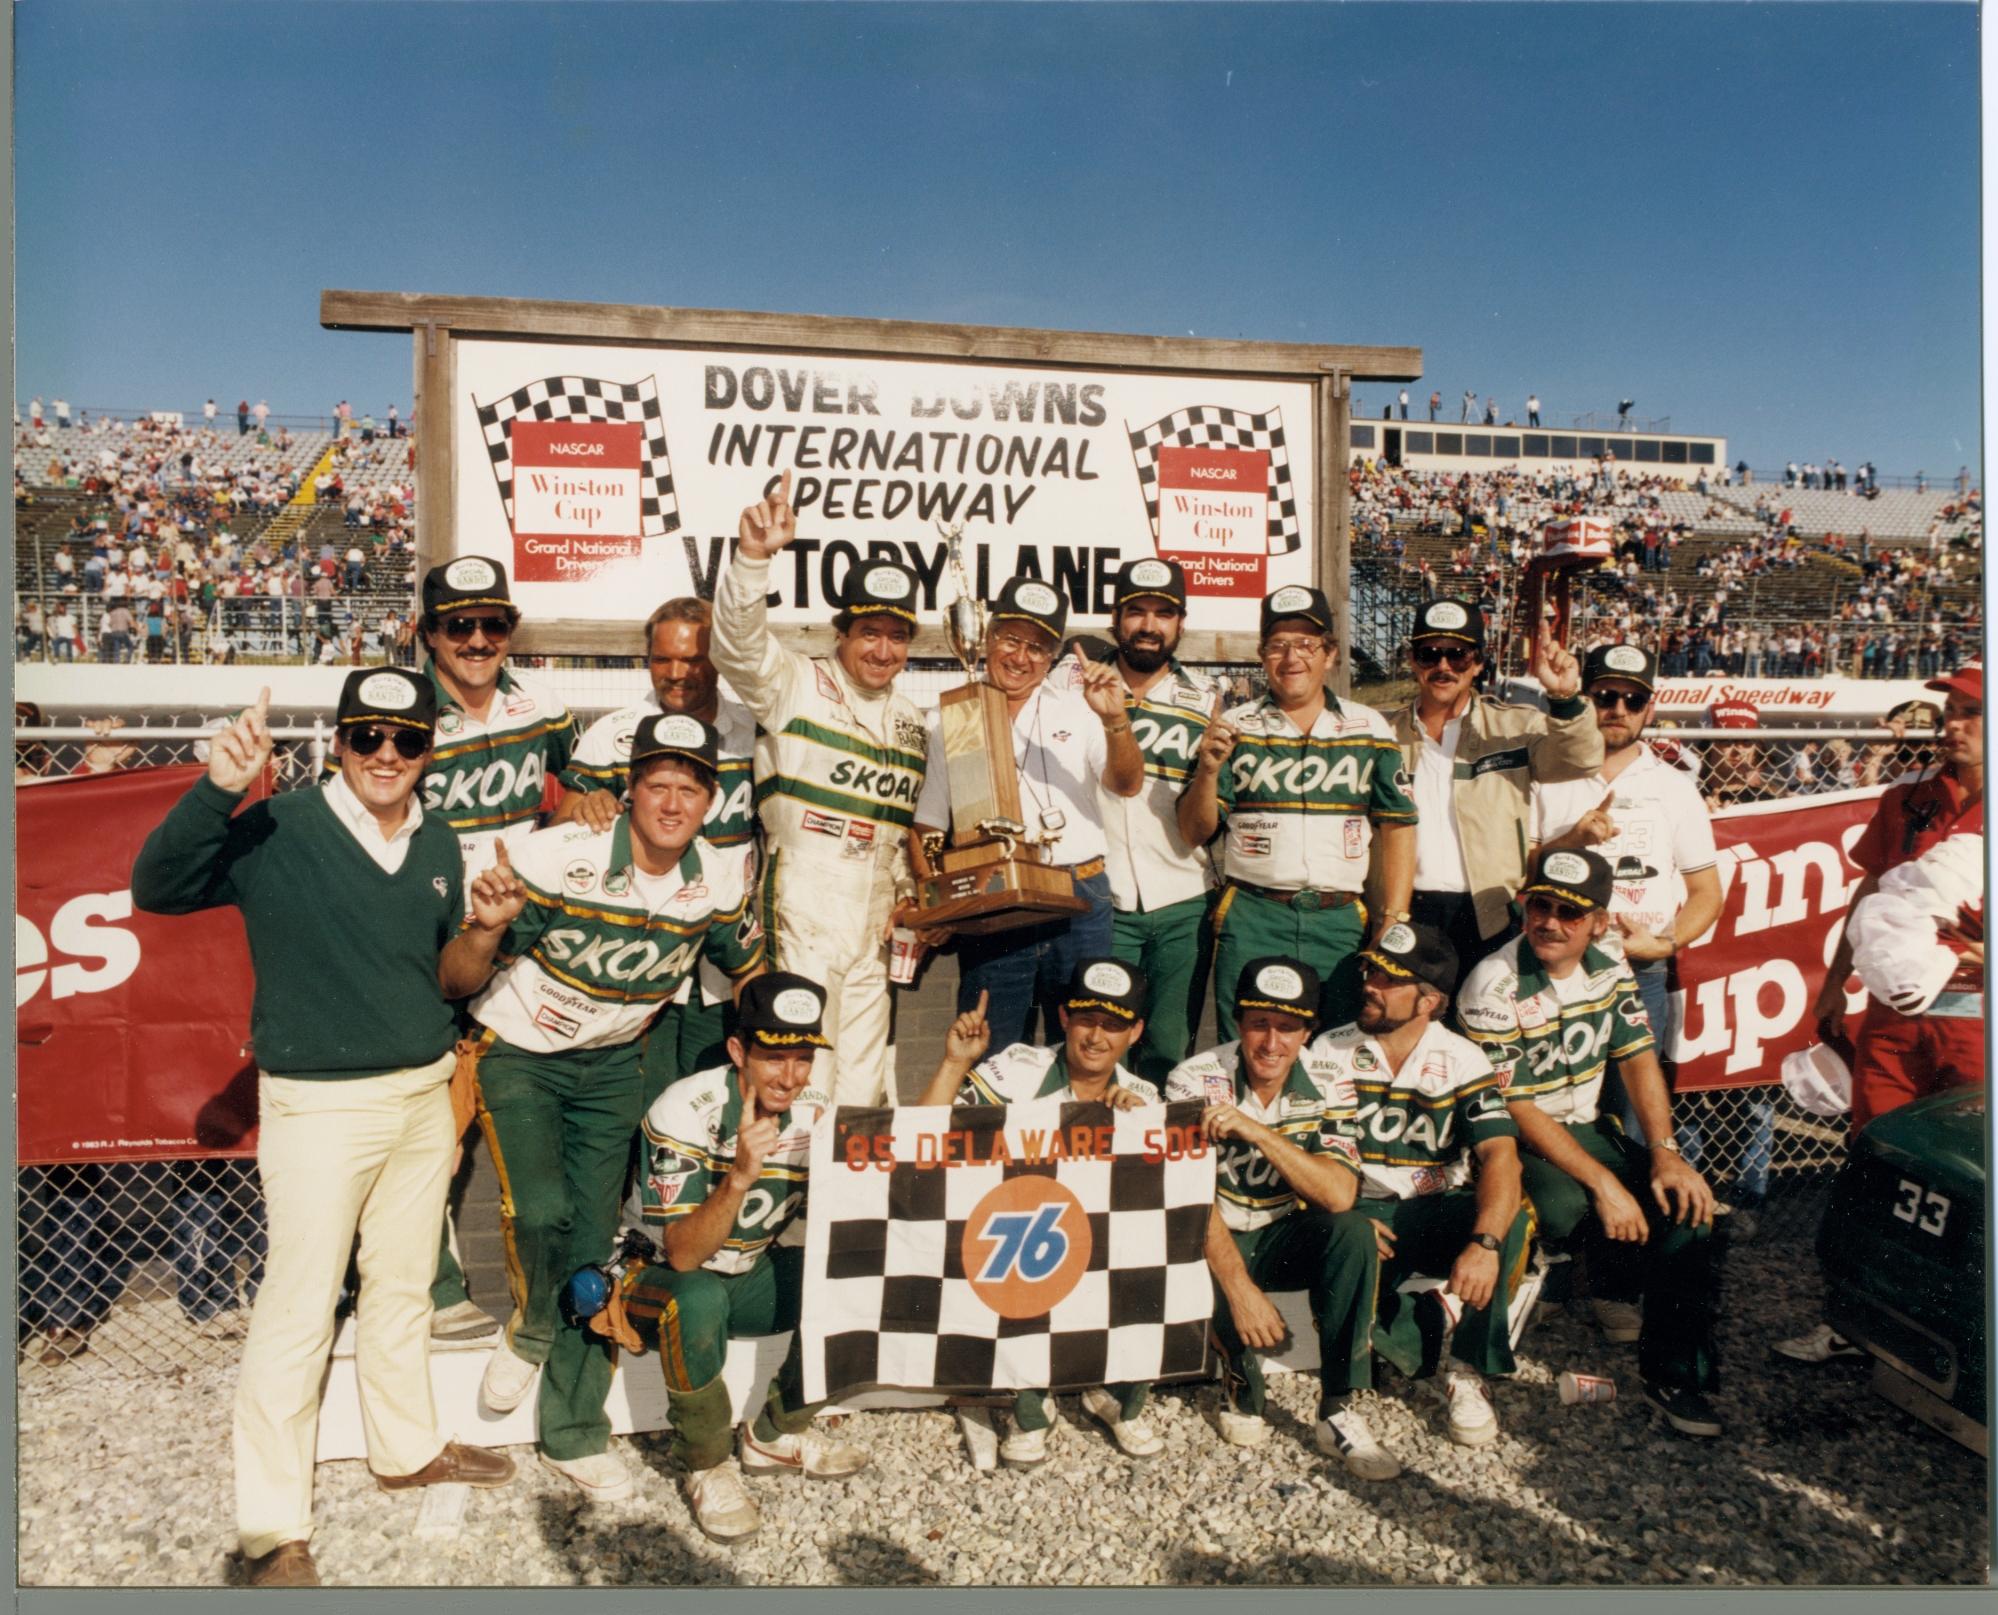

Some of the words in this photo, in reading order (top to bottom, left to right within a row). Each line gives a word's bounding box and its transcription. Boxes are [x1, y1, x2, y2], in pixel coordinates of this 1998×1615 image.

[704, 365, 881, 416] DOVER
[911, 379, 1107, 427] DOWNS
[550, 443, 605, 455] NASCAR
[708, 422, 1099, 480] INTERNATIONAL
[1191, 467, 1238, 480] NASCAR
[531, 473, 624, 497] Winston
[554, 499, 602, 529] Cup
[1174, 495, 1253, 518] Winston
[1193, 519, 1234, 547] Cup
[525, 539, 569, 554] Grand
[573, 540, 632, 555] National
[1209, 556, 1259, 572] National
[456, 574, 488, 585] BANDIT
[1193, 572, 1235, 586] Drivers
[873, 582, 903, 593] BANDIT
[368, 690, 406, 705] BANDIT
[1715, 684, 1836, 709] Speedway
[1715, 707, 1758, 721] Winston
[663, 731, 697, 744] BANDIT
[830, 760, 921, 803] SKOAL
[1232, 753, 1375, 795] SKOAL
[807, 817, 840, 831] CHAMPION
[1237, 820, 1279, 831] GOODYEAR
[1244, 841, 1269, 850] CHAMPION
[1548, 866, 1580, 880] BANDIT
[1616, 868, 1643, 876] SKOAL
[1091, 977, 1122, 992] BANDIT
[1263, 981, 1296, 994] BANDIT
[540, 983, 599, 1016] GOODYEAR
[782, 1007, 813, 1018] BANDIT
[541, 1011, 577, 1033] CHAMPION
[117, 1138, 153, 1148] Reynolds
[154, 1138, 186, 1146] Tobacco
[915, 1125, 1117, 1171] DELAWARE
[1143, 1125, 1208, 1165] 500
[1892, 1178, 1951, 1238] 33
[974, 1201, 1071, 1283] 76
